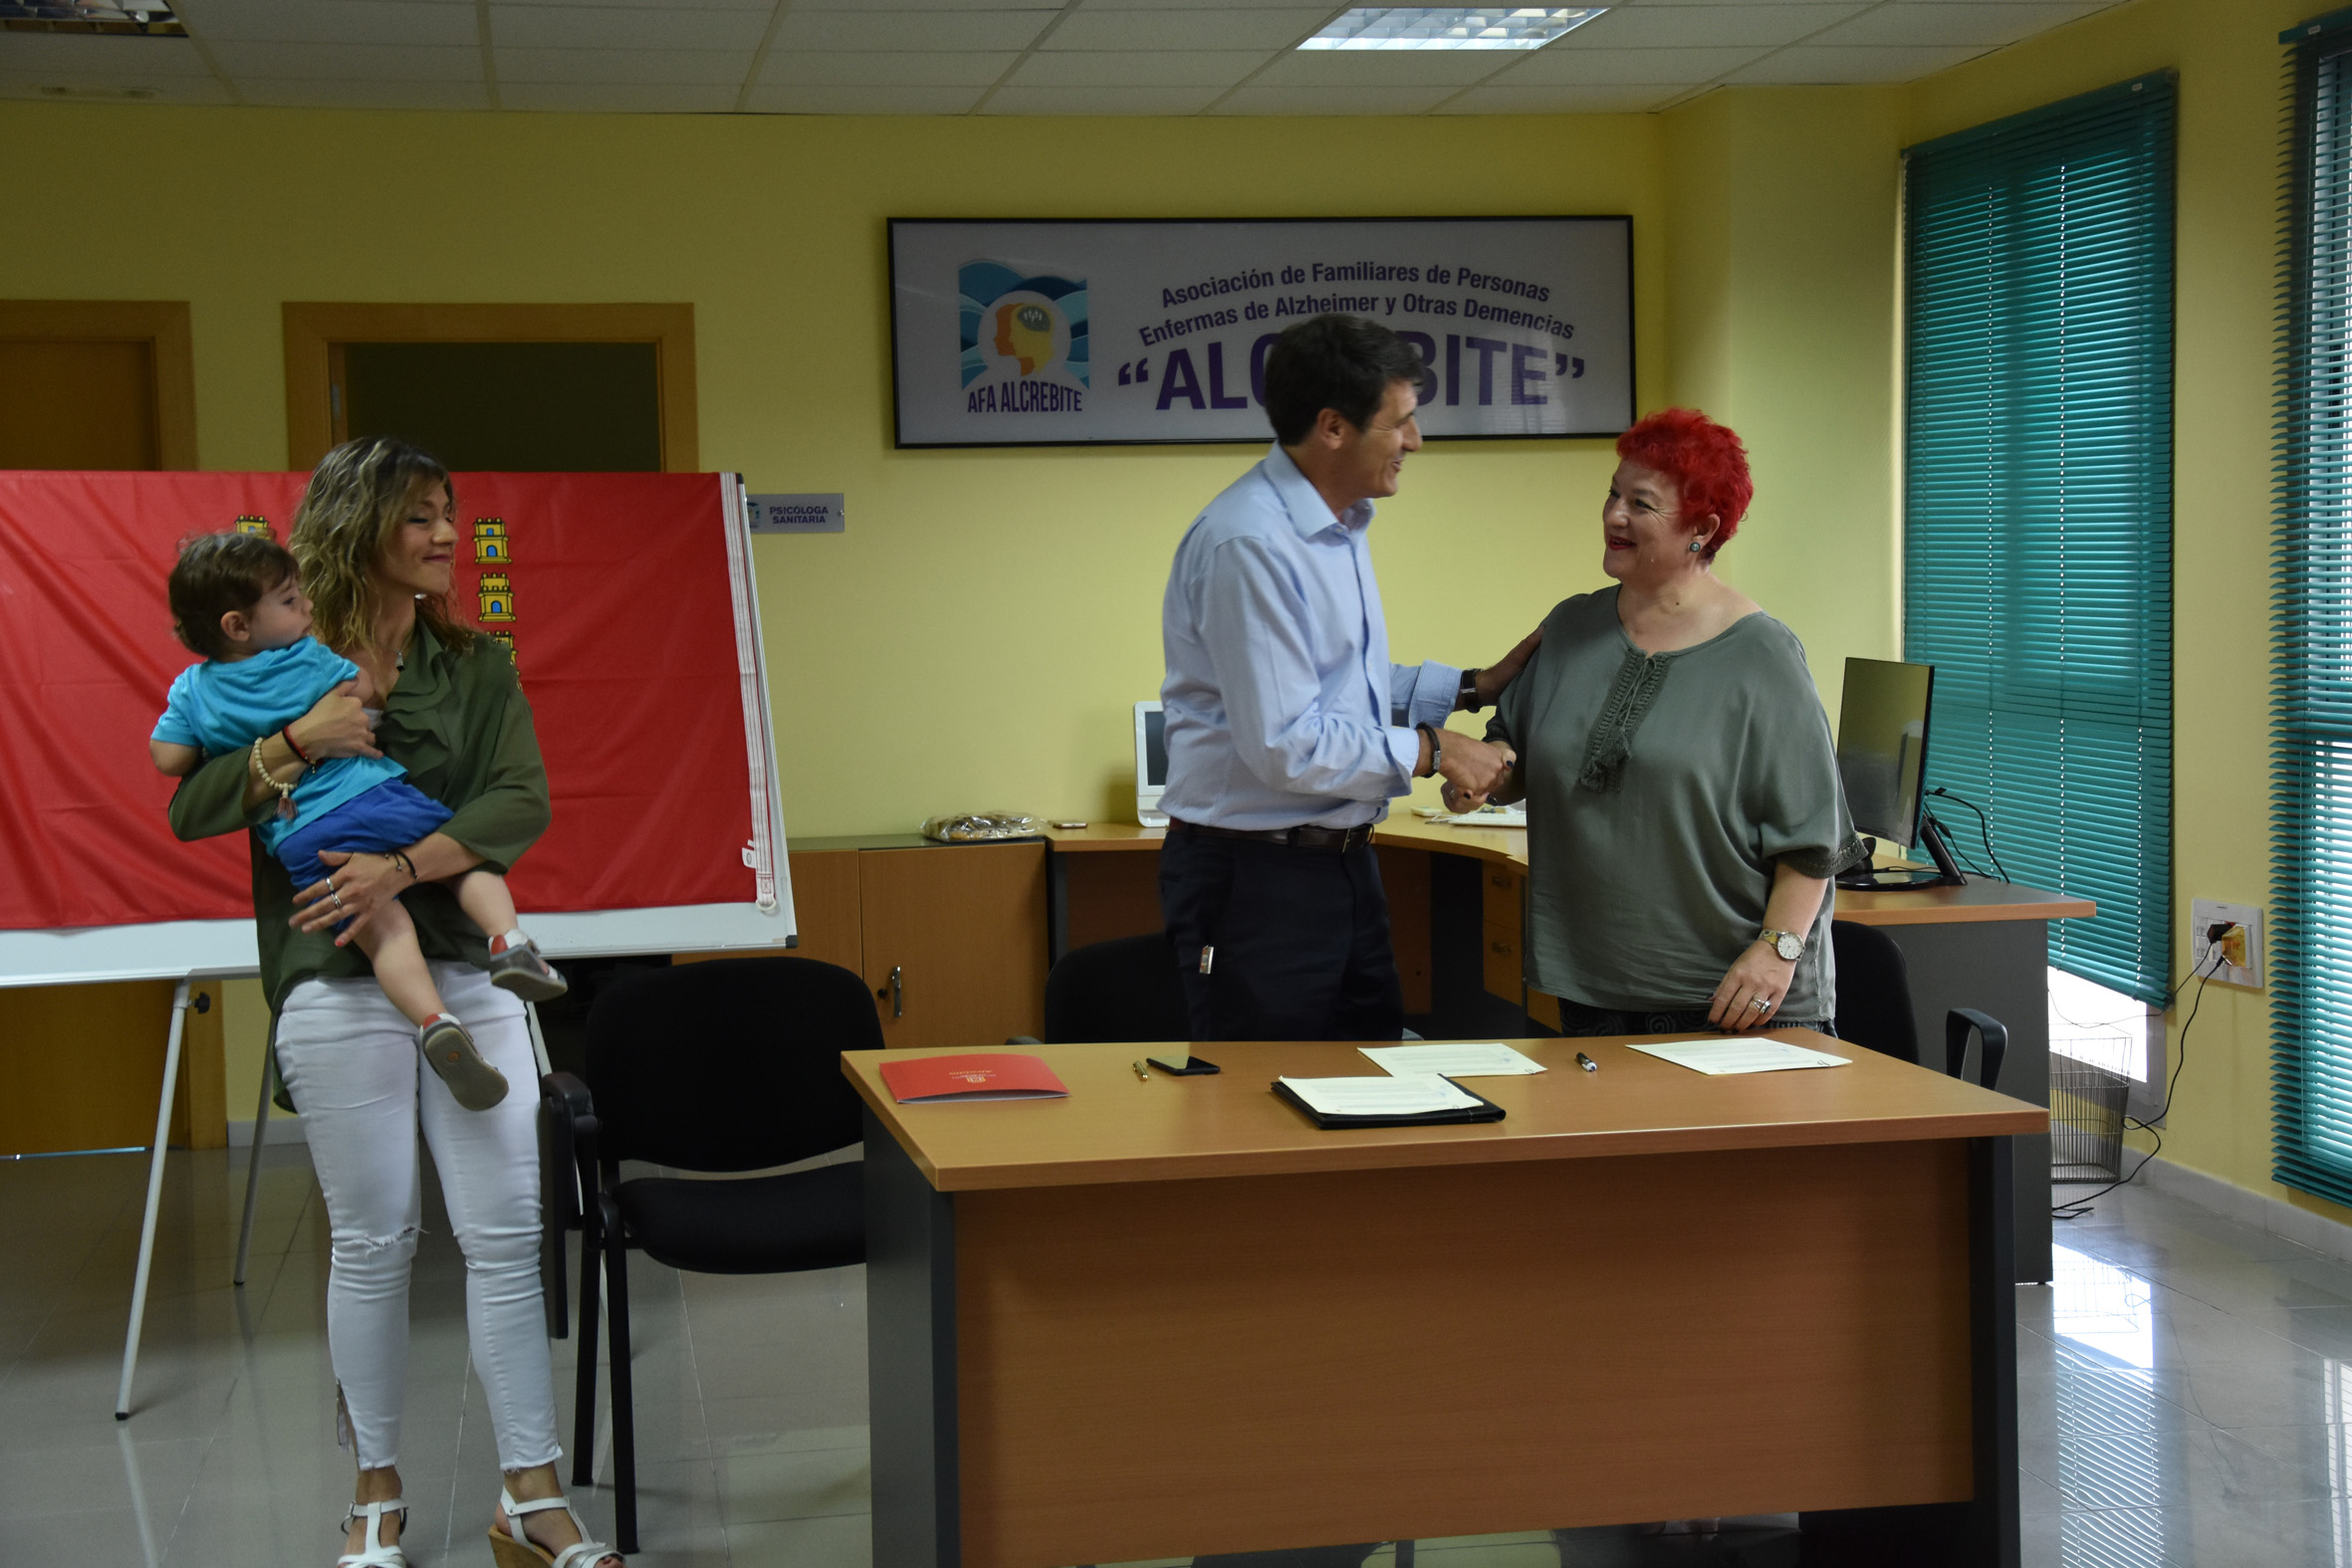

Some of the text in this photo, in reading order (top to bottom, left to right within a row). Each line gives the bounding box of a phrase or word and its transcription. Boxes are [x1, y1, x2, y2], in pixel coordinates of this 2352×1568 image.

[1162, 261, 1550, 308] Asociación de Familiares de Personas
[1138, 293, 1574, 347] Enfermas de Alzheimer y Otras Demencias
[1117, 330, 1585, 411] “ALBITE”
[967, 379, 1083, 413] AFA ALCREBITE
[769, 505, 828, 515] PSICÓLOGA
